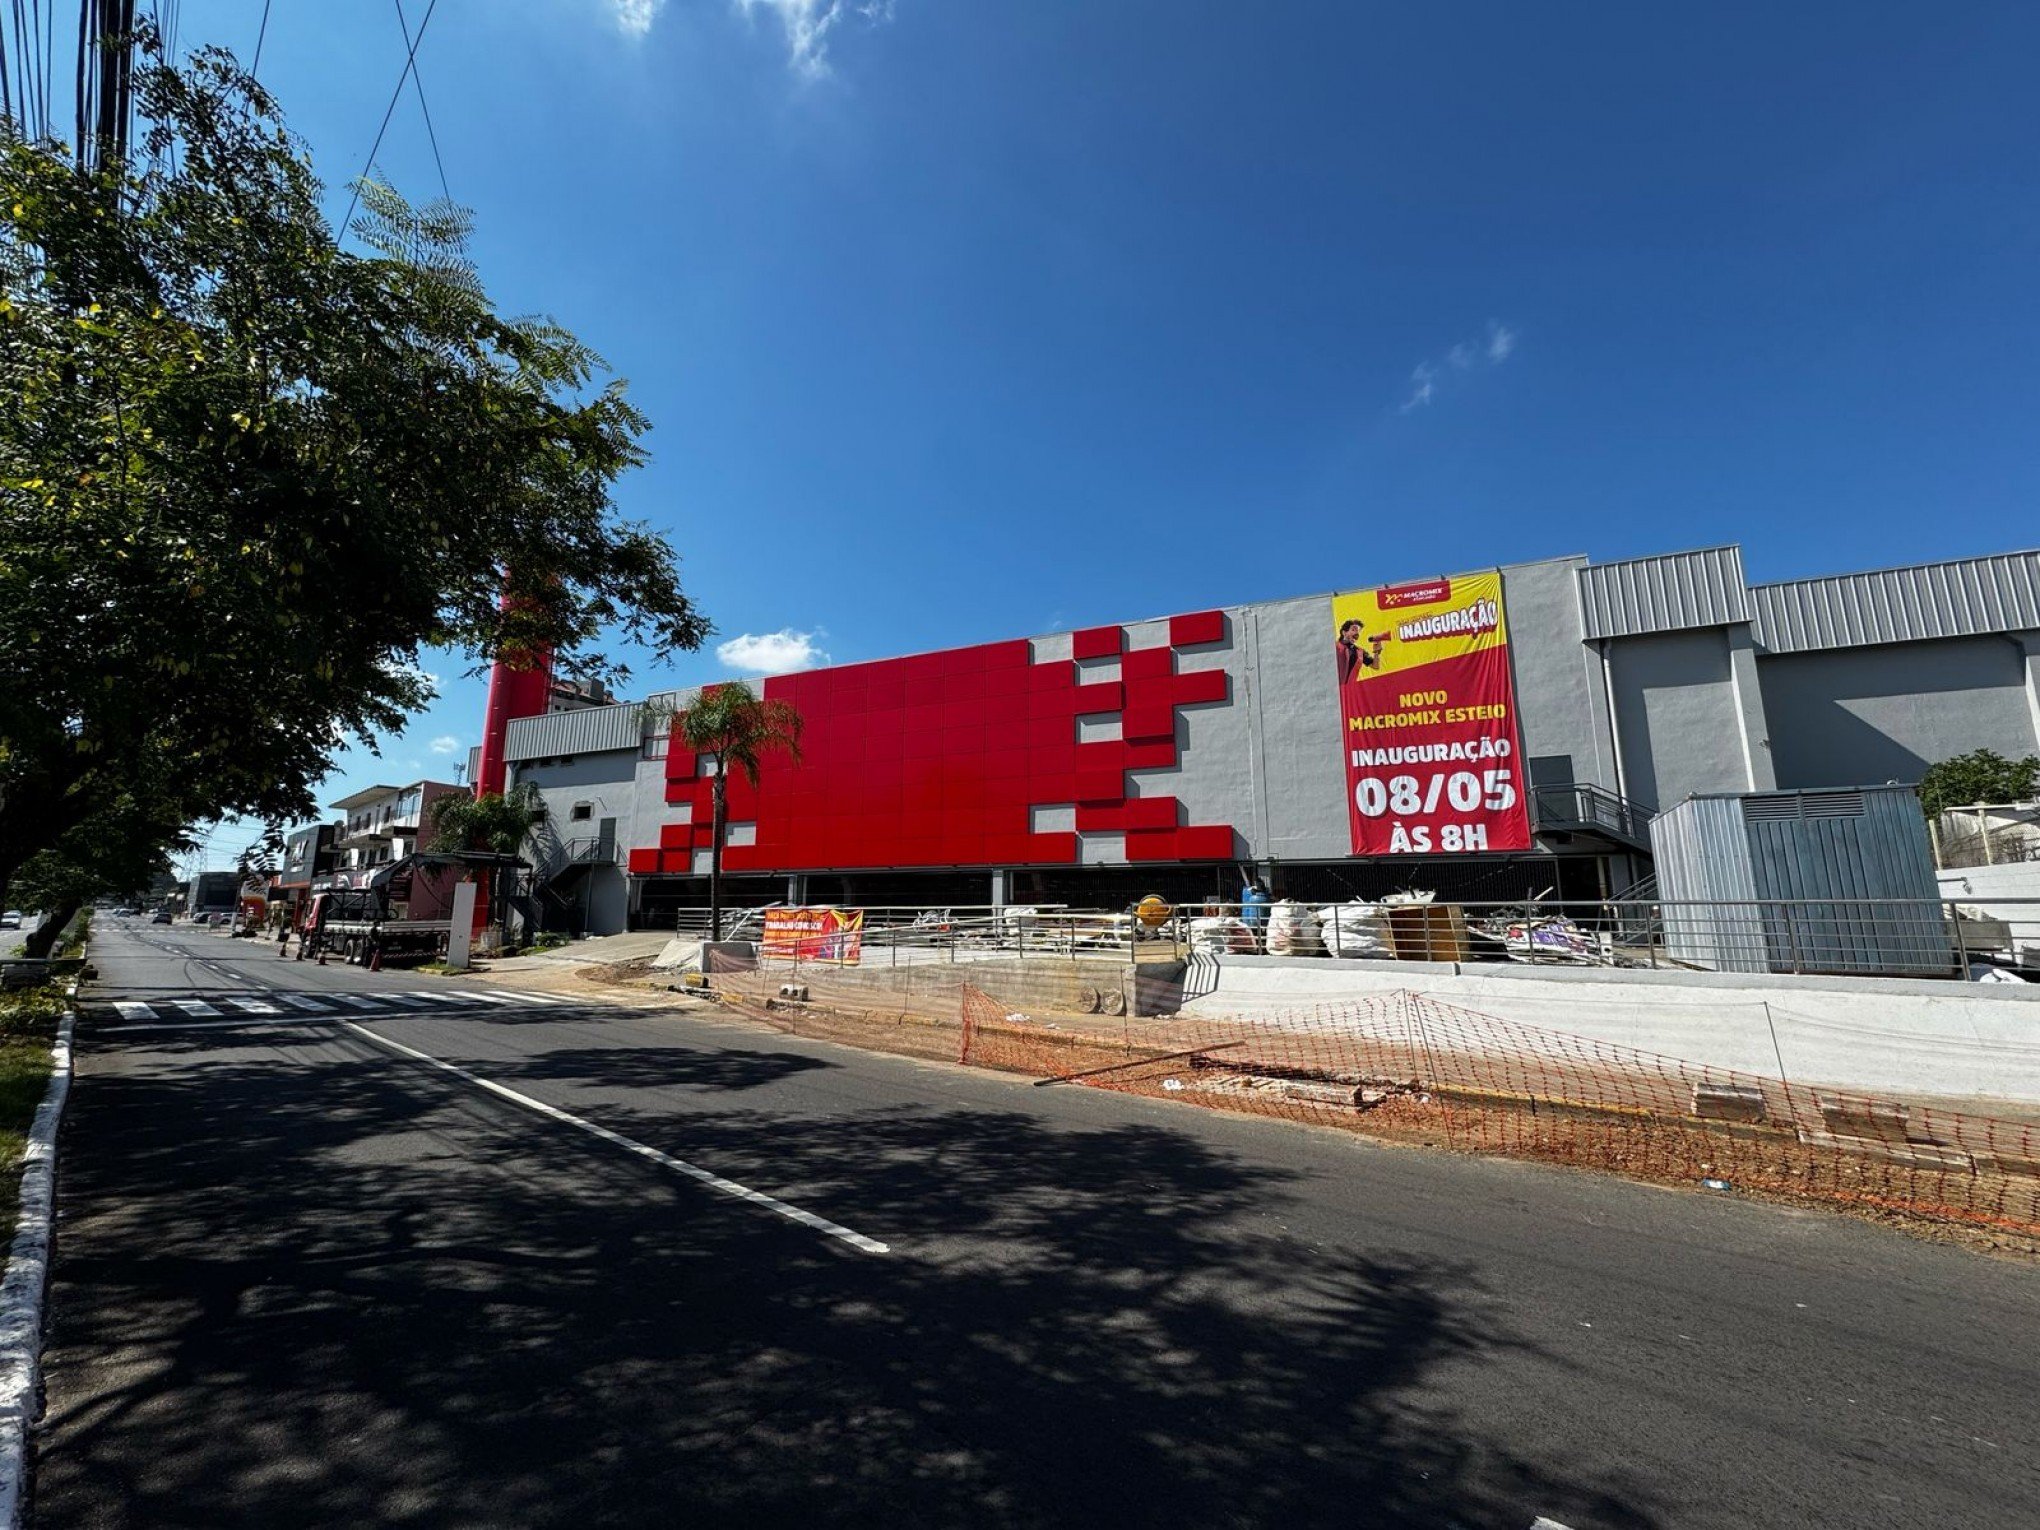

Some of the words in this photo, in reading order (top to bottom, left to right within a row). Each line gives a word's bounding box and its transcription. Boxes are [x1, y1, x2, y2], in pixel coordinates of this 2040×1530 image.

[1403, 588, 1443, 599] MACROMIX
[1399, 598, 1498, 639] INAUGURAÇÃO
[1399, 690, 1448, 708] NOVO
[1349, 709, 1442, 732] MACROMIX
[1445, 703, 1506, 724] ESTEIO
[1352, 736, 1512, 767] INAUGURAÇÃO
[1355, 769, 1516, 818] 08/05
[1389, 821, 1431, 853] ÀS
[1440, 823, 1489, 853] 8H
